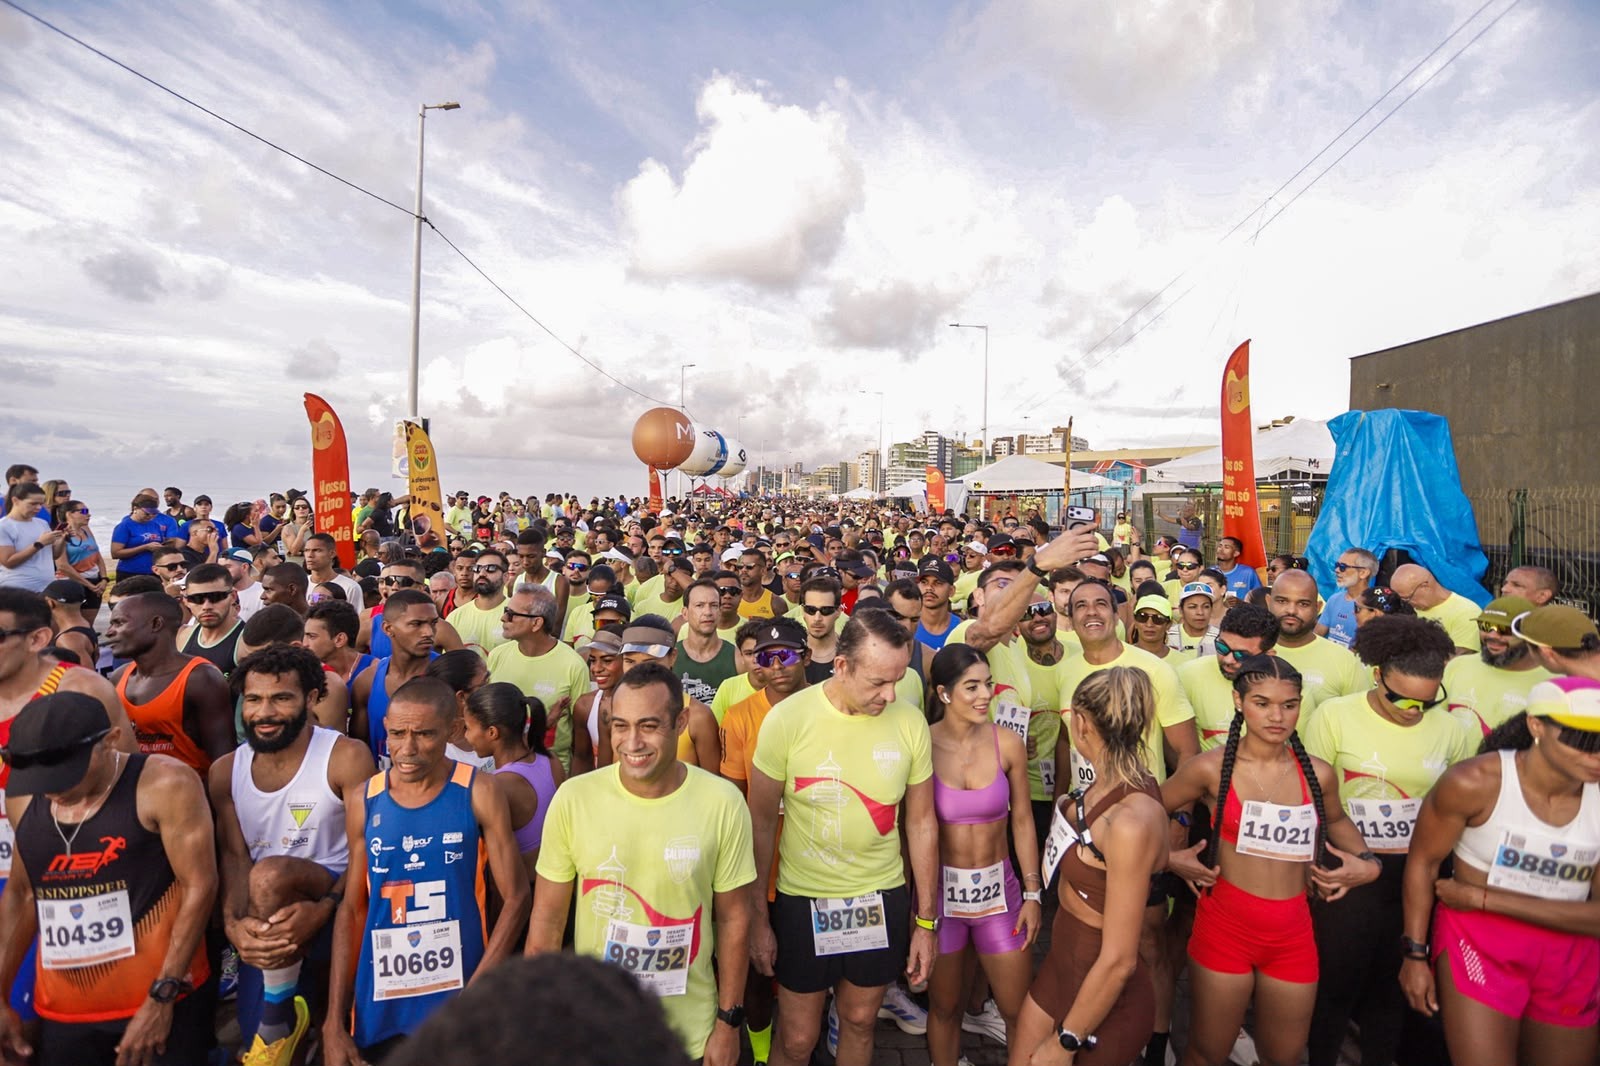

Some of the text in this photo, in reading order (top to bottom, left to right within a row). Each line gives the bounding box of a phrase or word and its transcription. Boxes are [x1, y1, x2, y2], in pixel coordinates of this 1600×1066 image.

[1237, 488, 1250, 503] só
[1243, 820, 1311, 845] 11021
[1502, 848, 1593, 882] 98800
[947, 882, 1001, 904] 11222
[45, 917, 125, 947] 10439
[817, 905, 881, 932] 98795
[379, 946, 455, 977] 10669
[609, 943, 685, 972] 98752
